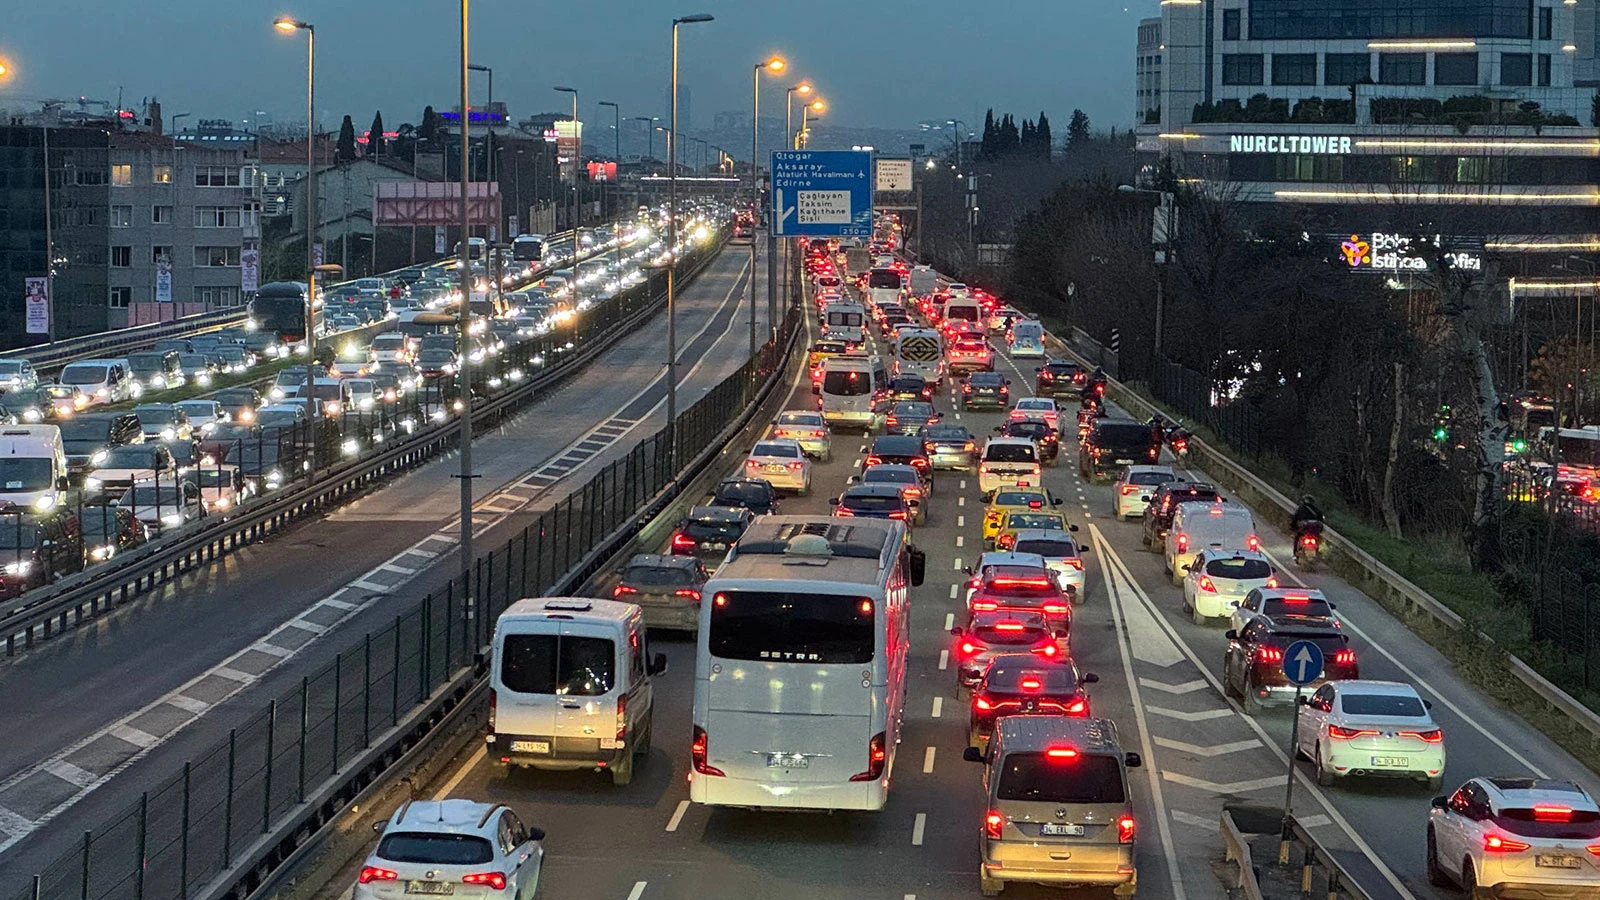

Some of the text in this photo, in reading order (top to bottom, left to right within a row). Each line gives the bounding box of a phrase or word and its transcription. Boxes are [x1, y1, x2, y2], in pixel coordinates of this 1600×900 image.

[776, 152, 812, 161] Otogar
[776, 163, 823, 171] Aksaray
[800, 192, 843, 200] Çağlayan
[1043, 825, 1052, 834] 34
